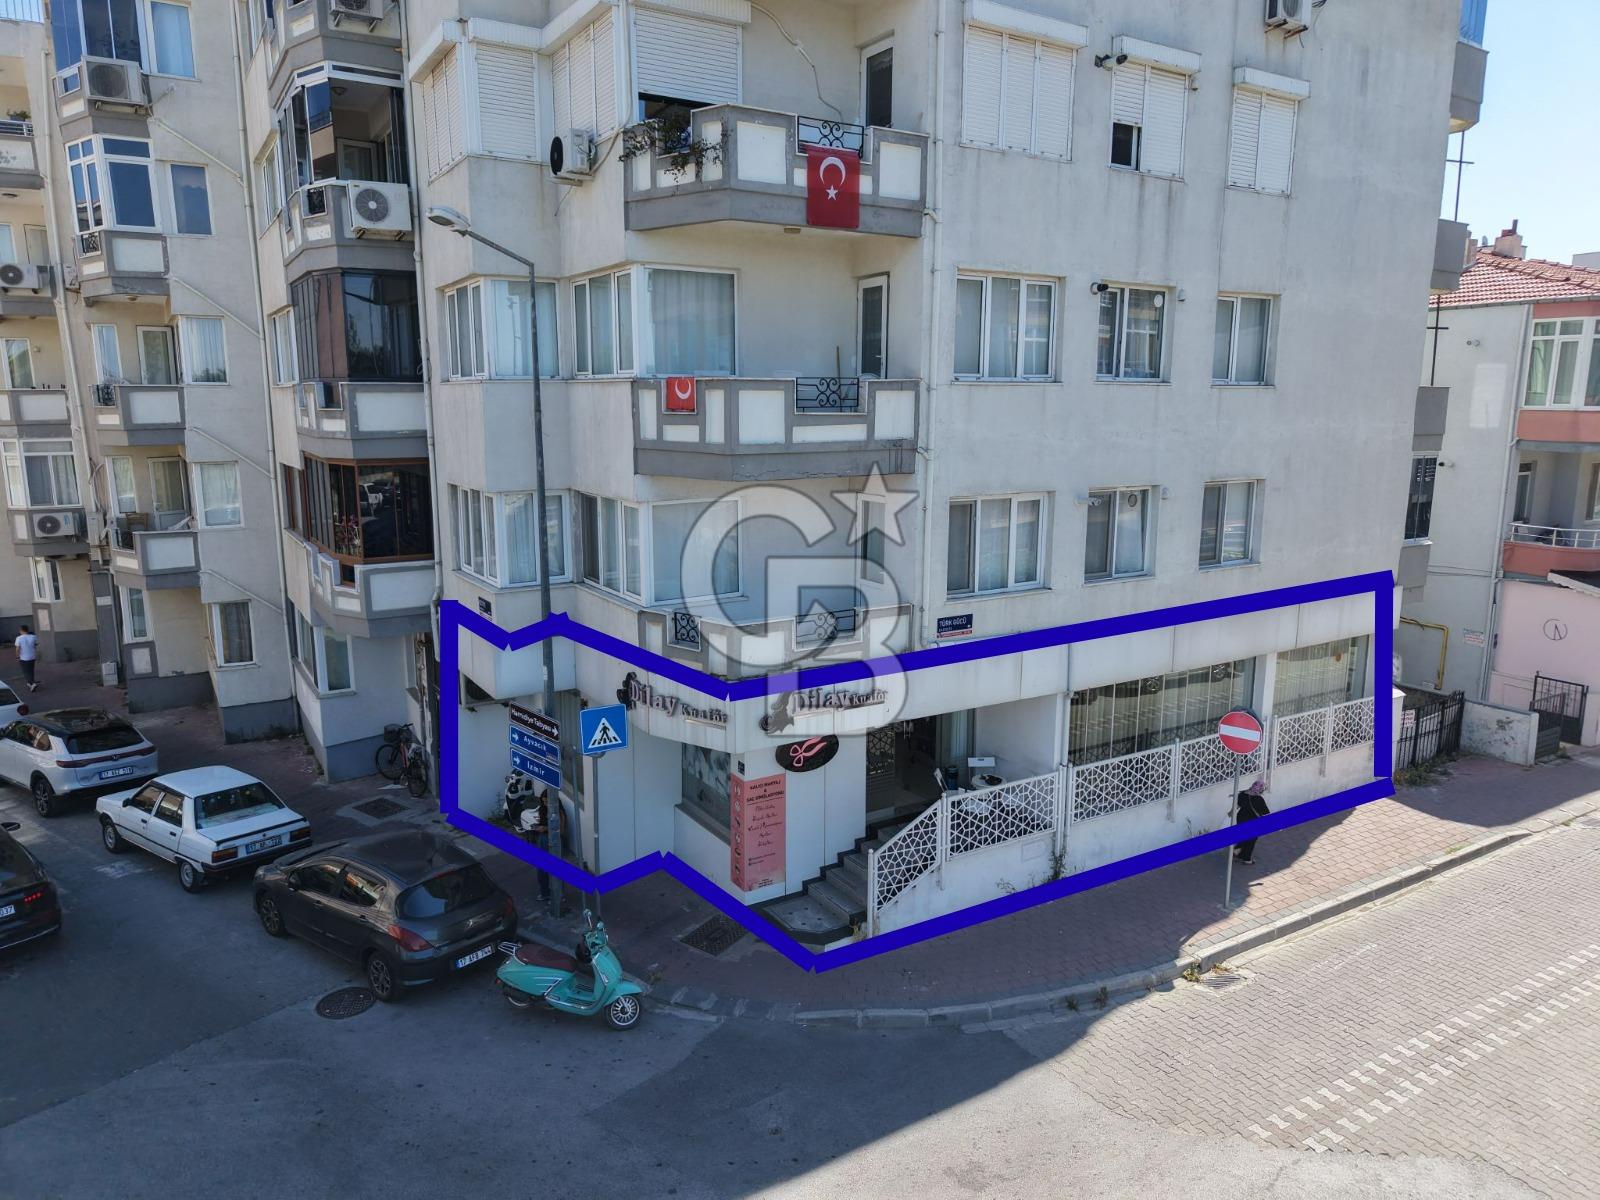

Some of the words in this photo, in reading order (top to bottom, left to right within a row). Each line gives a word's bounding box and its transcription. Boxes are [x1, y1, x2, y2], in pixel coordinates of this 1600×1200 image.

[939, 619, 953, 627] TÜRK
[953, 616, 967, 625] GÜCÜ
[628, 679, 679, 717] Dilay
[793, 687, 851, 714] Dilay
